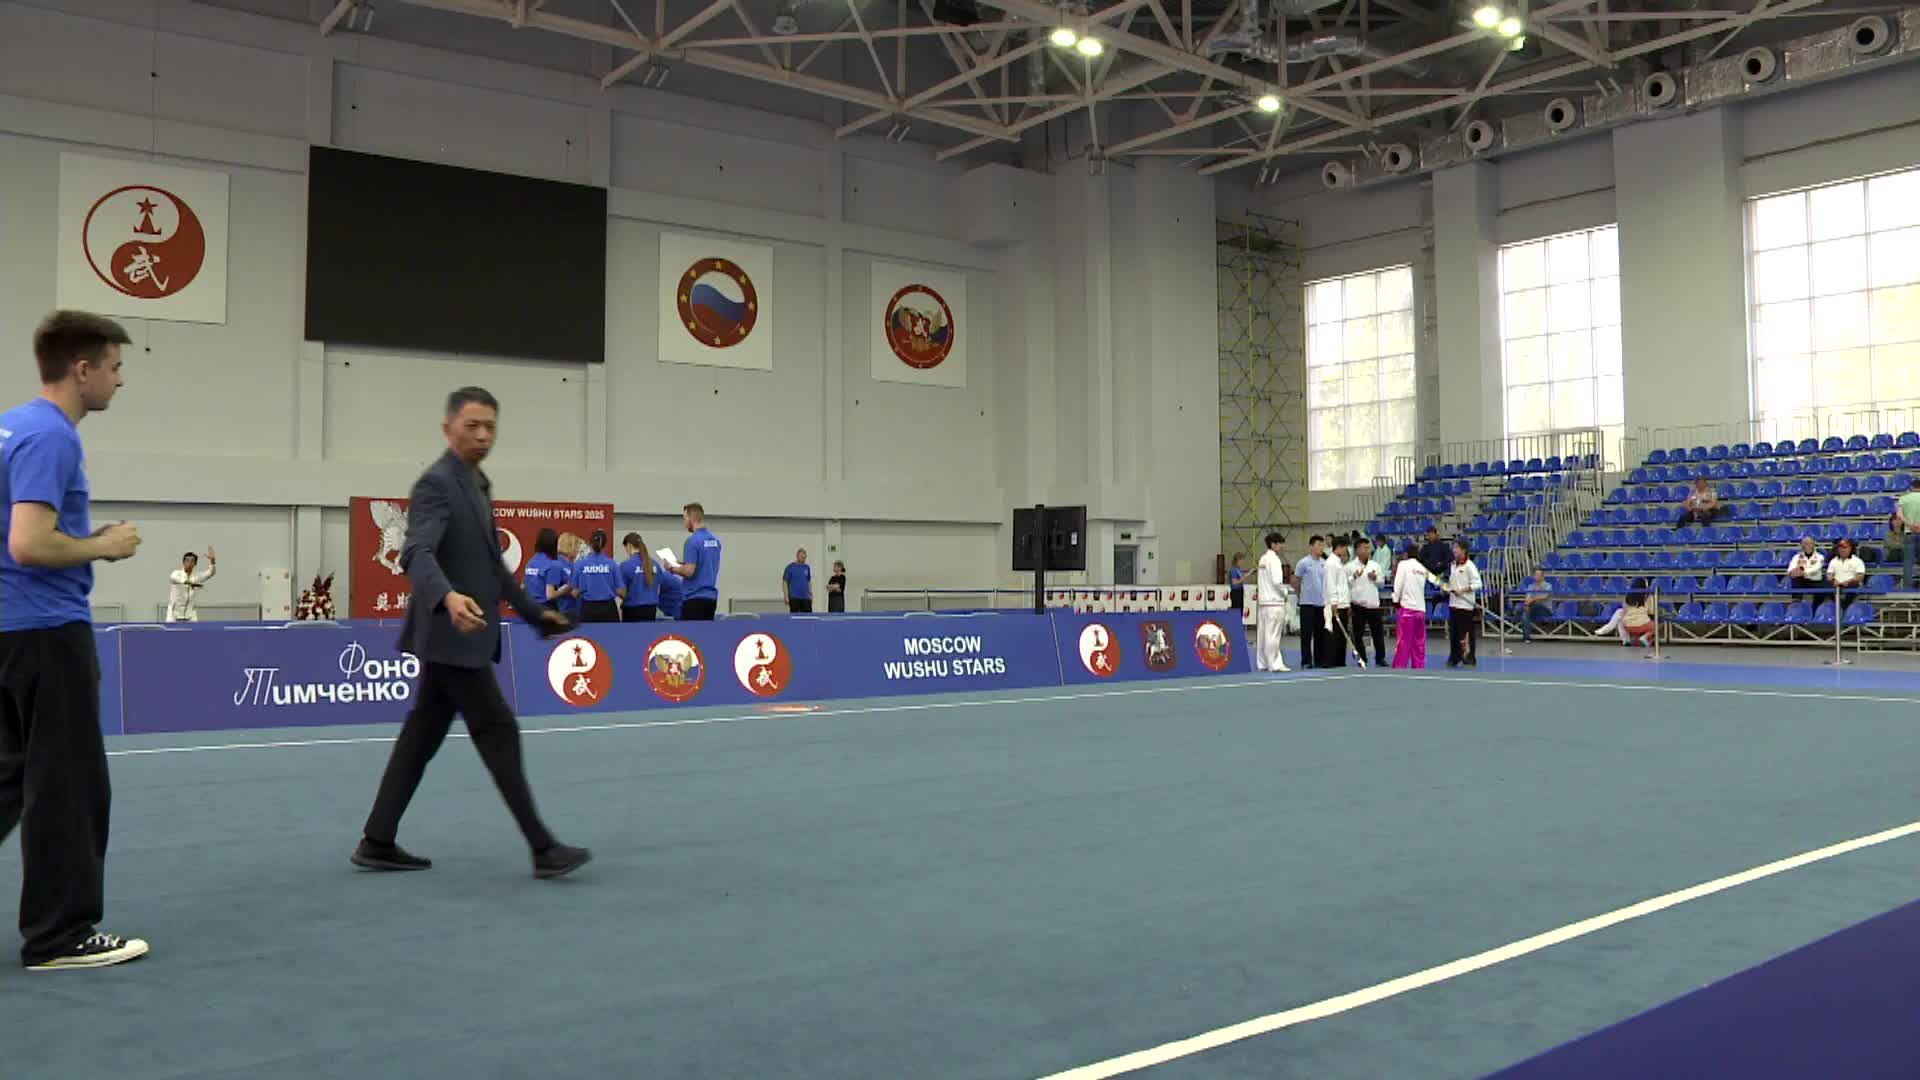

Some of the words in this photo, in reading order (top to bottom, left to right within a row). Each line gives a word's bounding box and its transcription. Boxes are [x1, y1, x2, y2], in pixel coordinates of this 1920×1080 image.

[123, 246, 169, 291] 武
[493, 507, 515, 518] COW
[517, 507, 552, 519] WUSHU
[555, 509, 583, 520] STARS
[339, 640, 420, 679] Фонд
[904, 635, 981, 656] MOSCOW
[883, 659, 949, 680] WUSHU
[952, 657, 1007, 676] STARS
[234, 667, 410, 706] Тимченко
